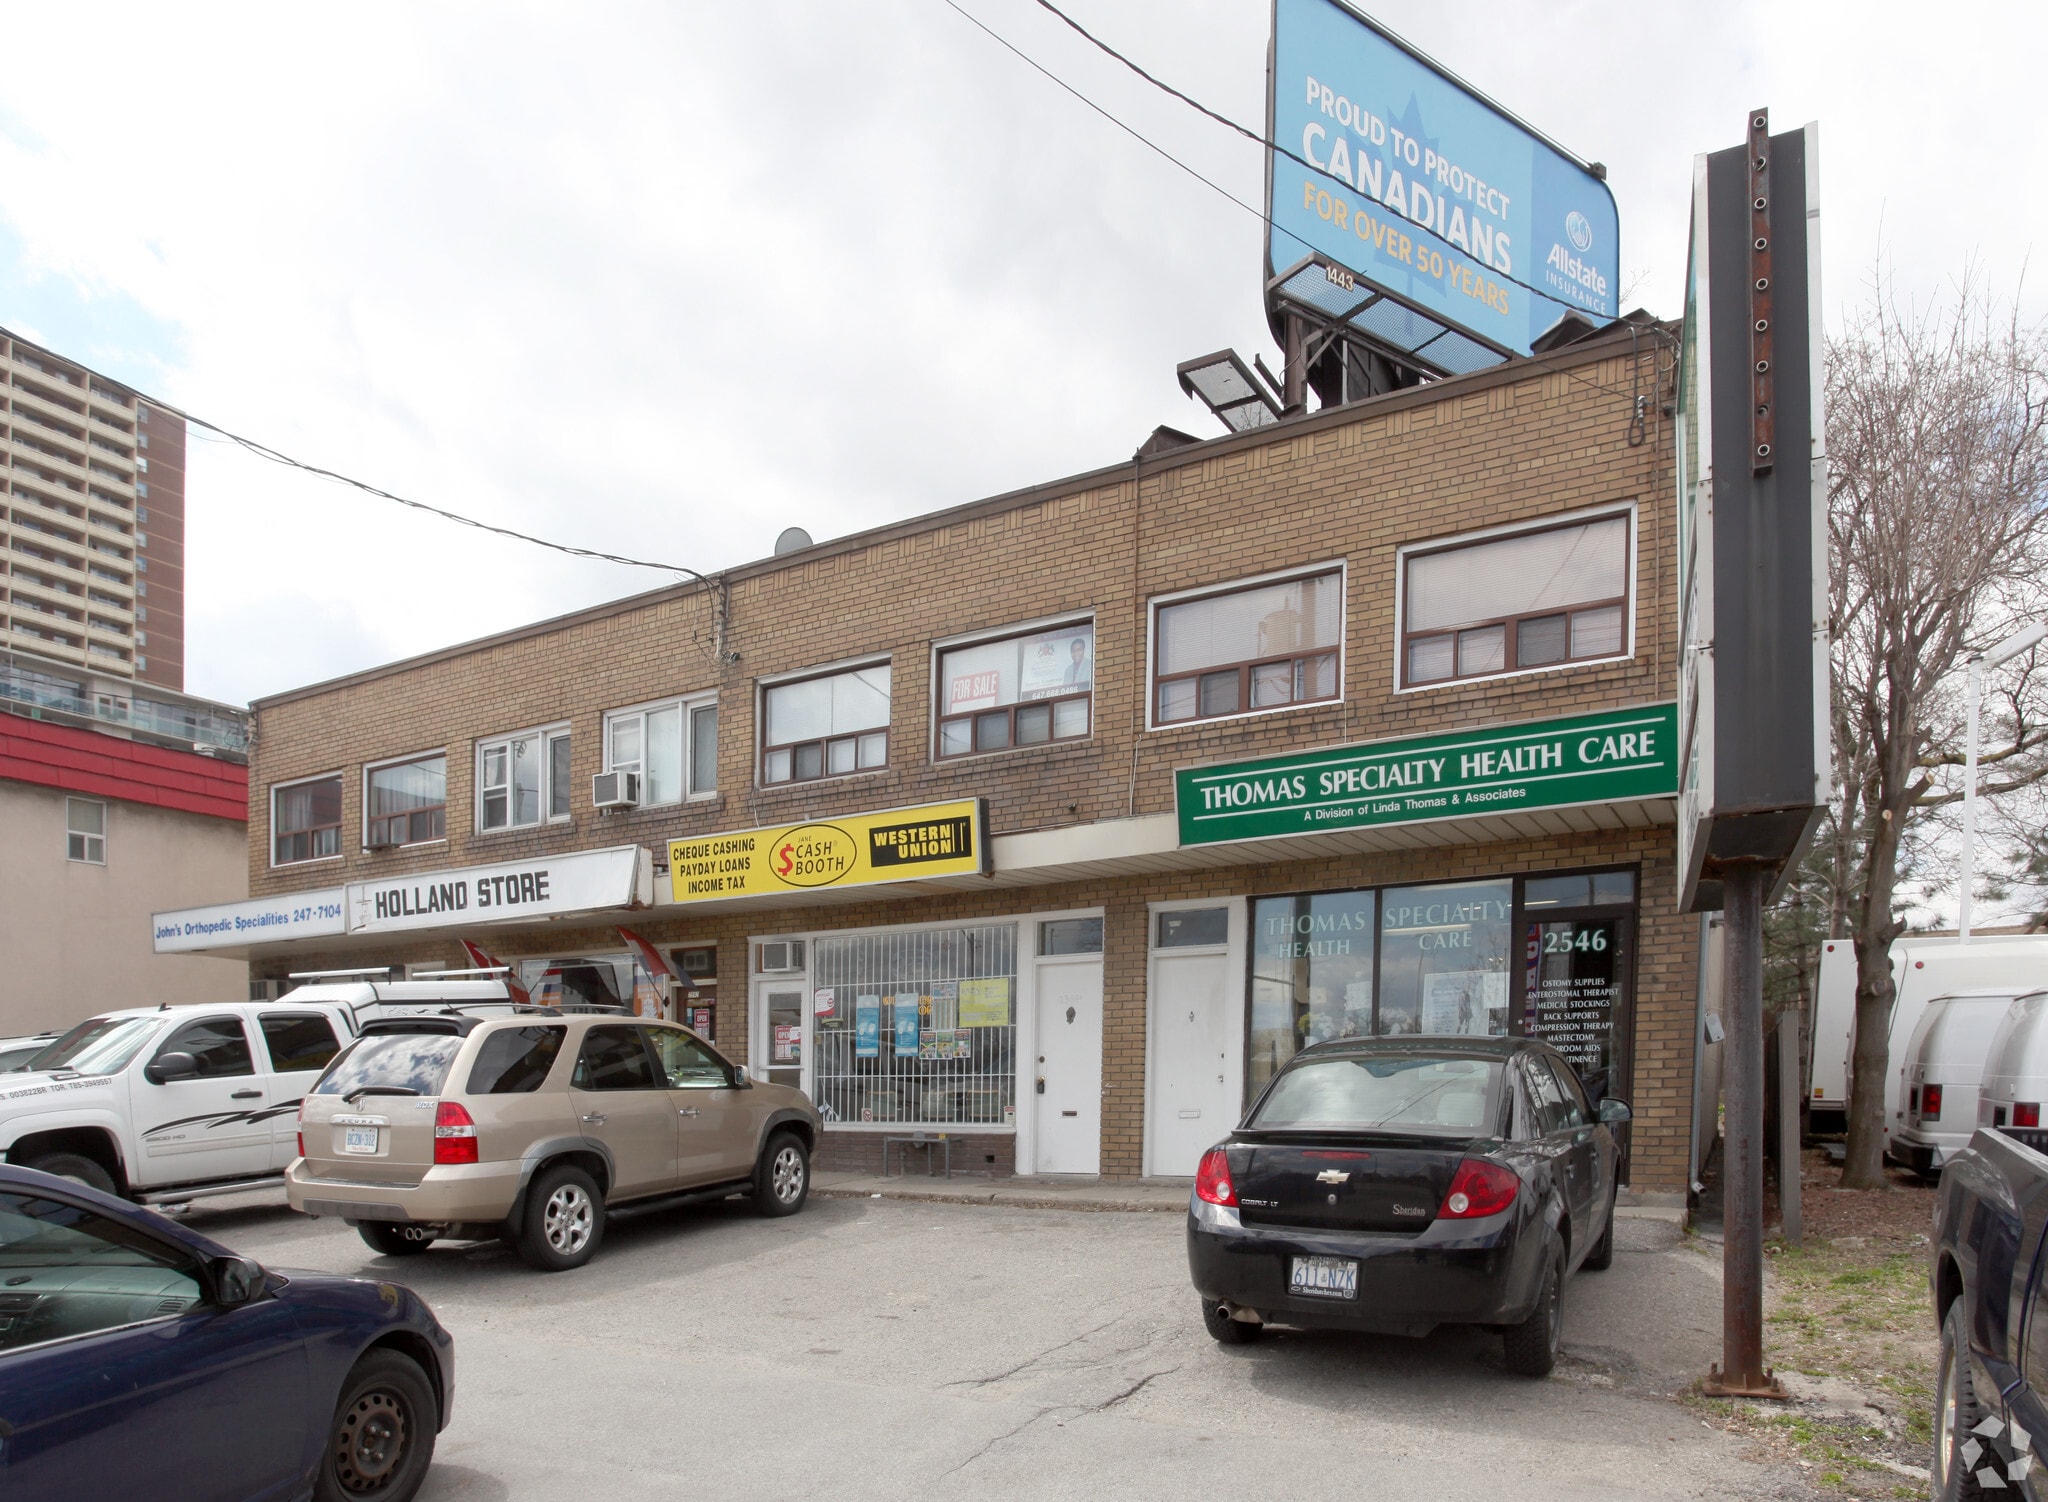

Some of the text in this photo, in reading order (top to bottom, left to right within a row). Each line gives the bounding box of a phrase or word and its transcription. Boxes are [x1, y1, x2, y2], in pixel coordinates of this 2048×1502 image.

[1306, 76, 1510, 221] PROUD TO PROTECT
[1302, 122, 1512, 276] CANADIANS
[1303, 181, 1509, 315] FOR OVER 50 YEARS
[1325, 265, 1354, 291] 1443
[1546, 243, 1607, 297] Allstate
[1546, 270, 1606, 315] INSURANCE
[952, 673, 998, 700] FOR SALE
[1201, 730, 1656, 810] THOMAS SPECIALTY HEALTH CARE
[1304, 787, 1526, 821] A Division of Linda Thomas & Associates
[797, 835, 812, 843] JANE
[874, 824, 951, 847] WESTERN
[673, 838, 756, 861] CHEQUE CASHING
[795, 841, 833, 859] CASH
[898, 840, 951, 859] UNION
[680, 856, 751, 878] PAYDAY LOANS
[795, 856, 845, 875] BOOTH
[376, 870, 549, 918] HOLLAND STORE
[688, 875, 746, 894] INCOME TAX
[156, 924, 182, 939] John's
[185, 918, 232, 936] Orthopedic
[235, 911, 289, 932] Specialities
[1267, 899, 1511, 936] THOMAS SPECIALTY
[1278, 931, 1473, 960] HEALTH CARE
[1544, 929, 1607, 953] 2546
[1528, 987, 1620, 999] ENTEROSTOMAL THERAPIST
[1542, 978, 1606, 987] OSTOMY SUPPLIES
[1536, 999, 1610, 1009] MEDICAL STOCKINGS
[1530, 1022, 1615, 1032] COMPRESSION THERAPY
[1543, 1011, 1600, 1021] BACK SUPPORTS
[1546, 1033, 1596, 1042] MASTECTOMY
[1584, 1044, 1601, 1052] AIDS
[415, 1101, 434, 1109] MDX
[1241, 1198, 1267, 1206] COBALT
[1392, 1203, 1426, 1217] Sheridan
[1294, 1266, 1355, 1290] 611 NZK
